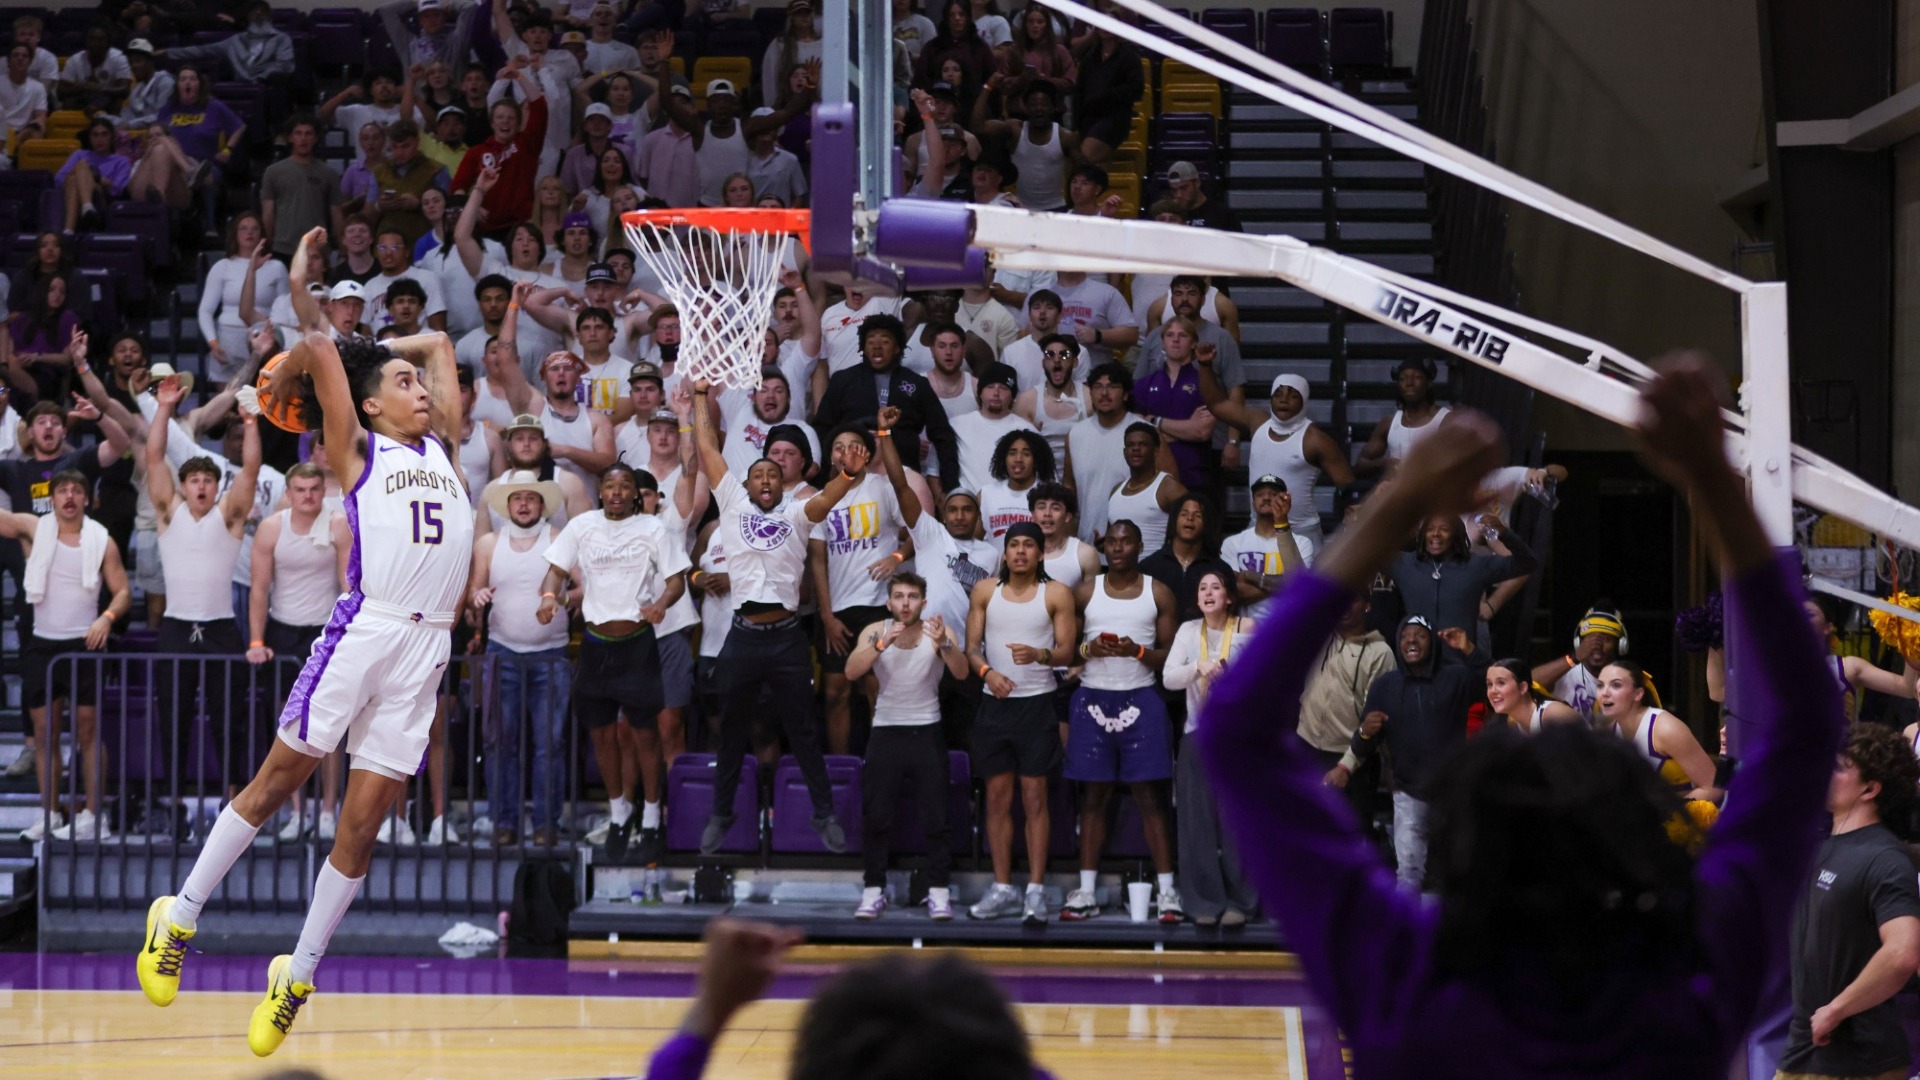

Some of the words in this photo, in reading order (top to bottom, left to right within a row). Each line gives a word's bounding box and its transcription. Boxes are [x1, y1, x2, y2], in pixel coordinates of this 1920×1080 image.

[386, 468, 458, 499] COWBOYS
[410, 500, 444, 545] 15
[827, 503, 879, 541] STAY
